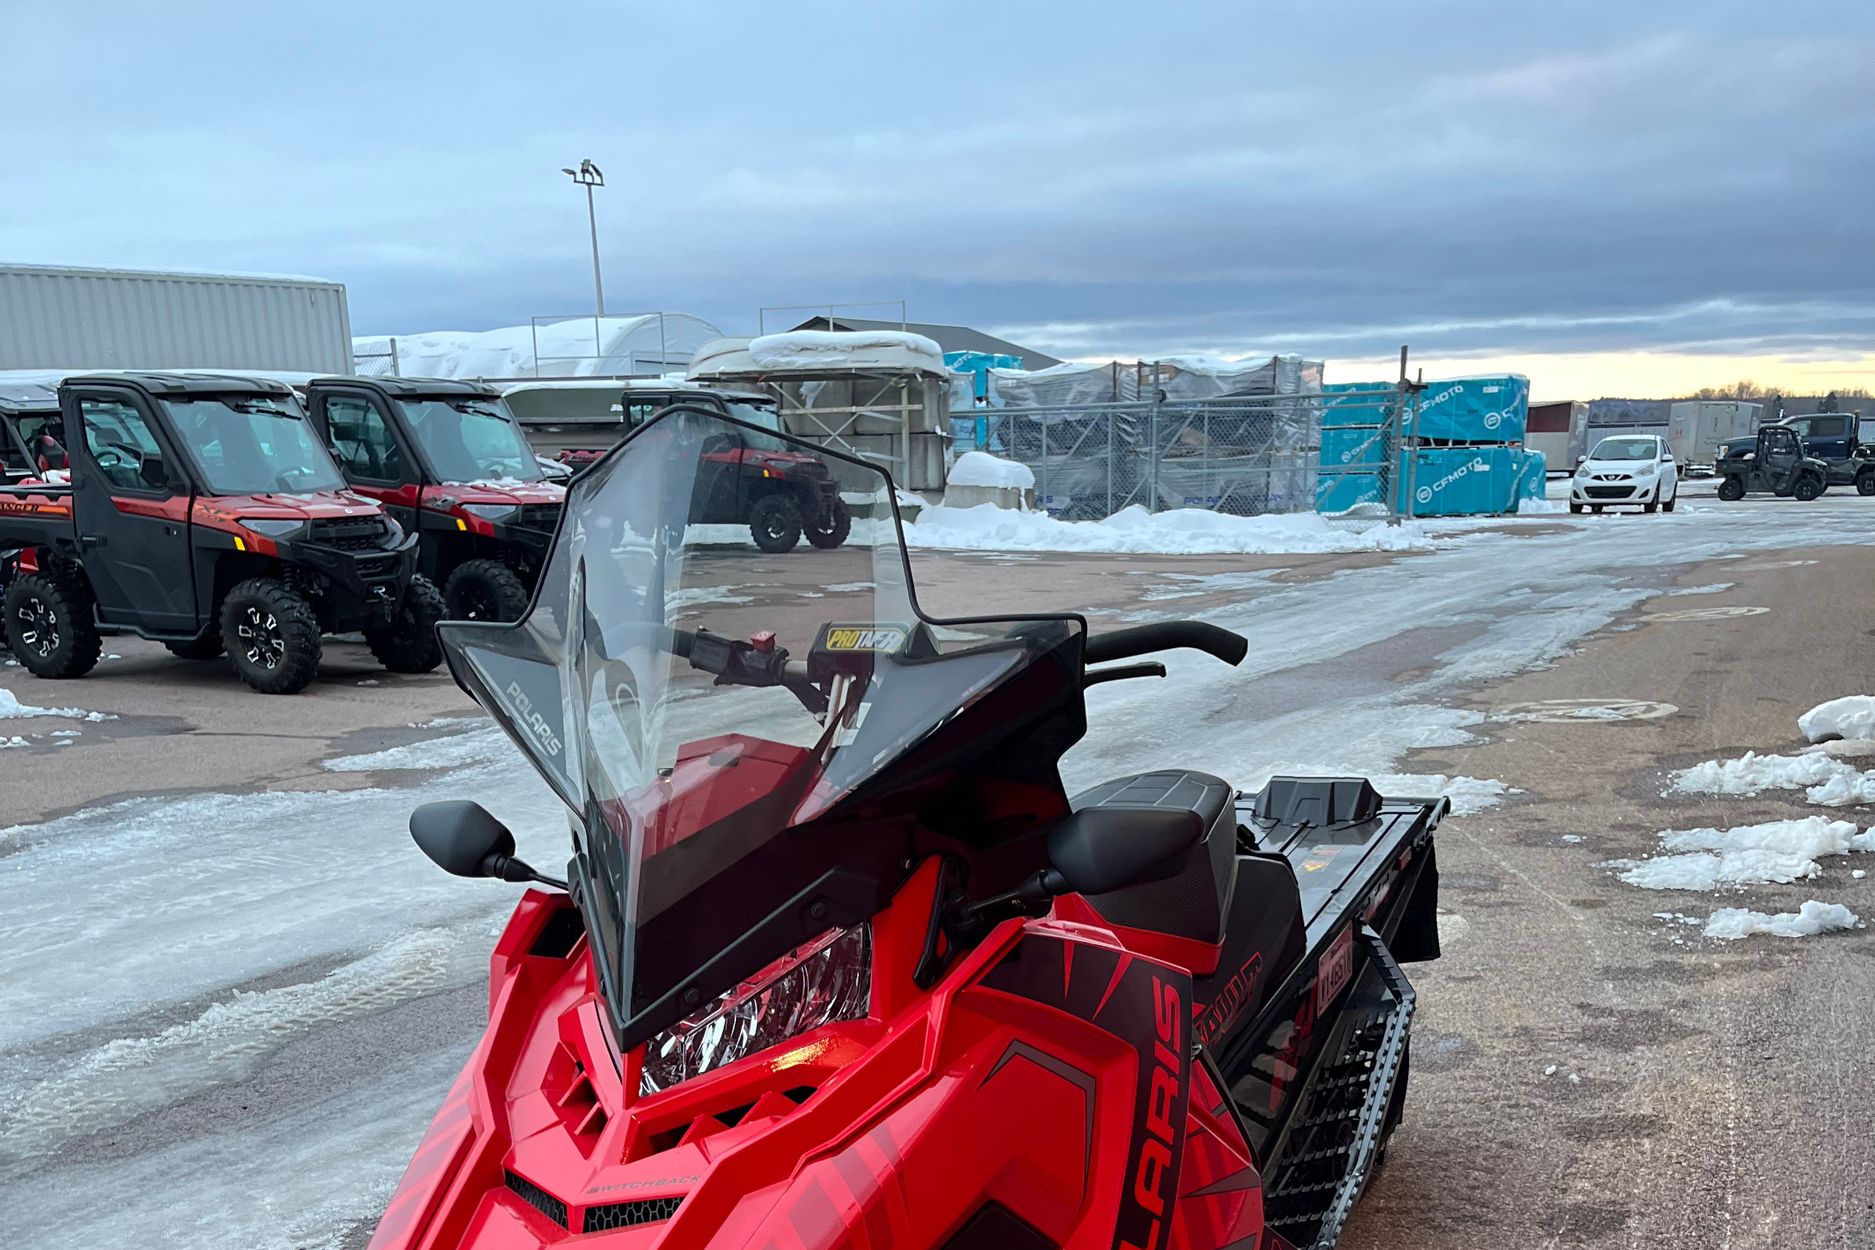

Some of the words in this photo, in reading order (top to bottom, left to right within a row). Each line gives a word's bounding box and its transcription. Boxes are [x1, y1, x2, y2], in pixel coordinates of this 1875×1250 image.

[1432, 457, 1483, 492] CFMOTO
[506, 681, 562, 756] POLARIS
[586, 1175, 701, 1194] SWITCHBACK
